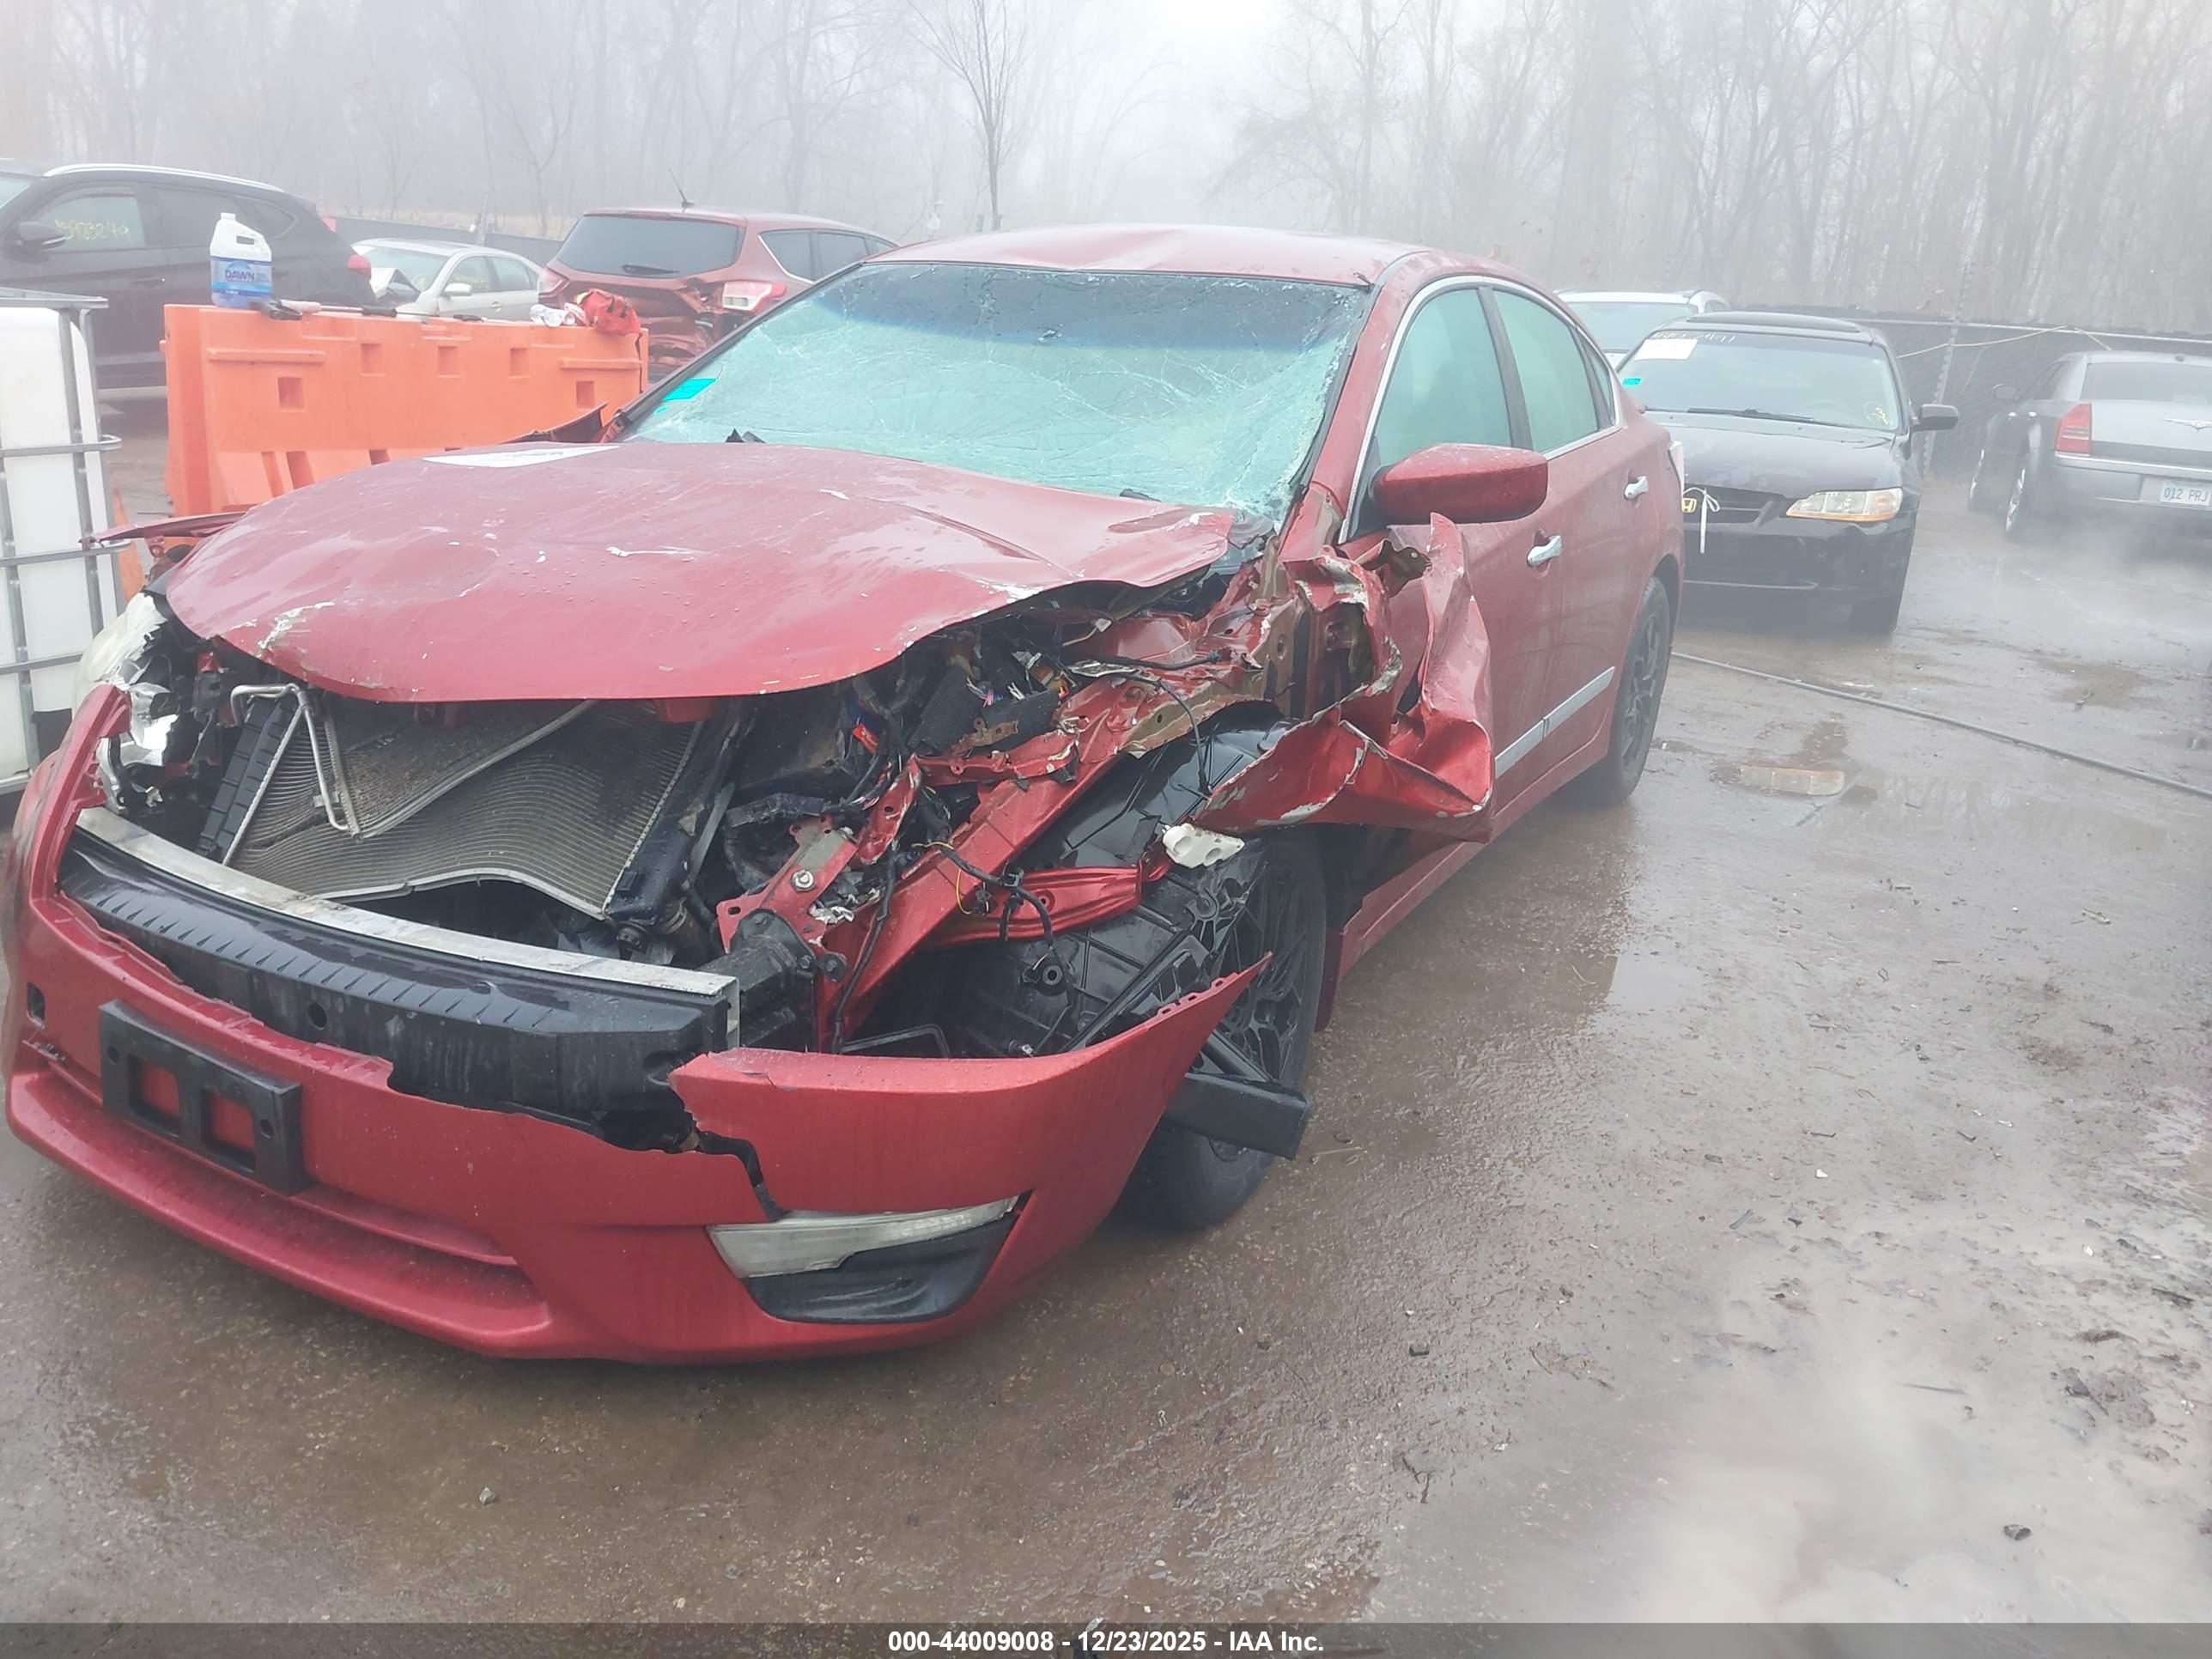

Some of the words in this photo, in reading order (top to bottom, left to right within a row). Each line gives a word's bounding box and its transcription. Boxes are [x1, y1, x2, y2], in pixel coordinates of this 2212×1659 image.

[225, 270, 255, 282] DAWN
[2164, 487, 2184, 500] 012
[2189, 489, 2209, 502] PRJ
